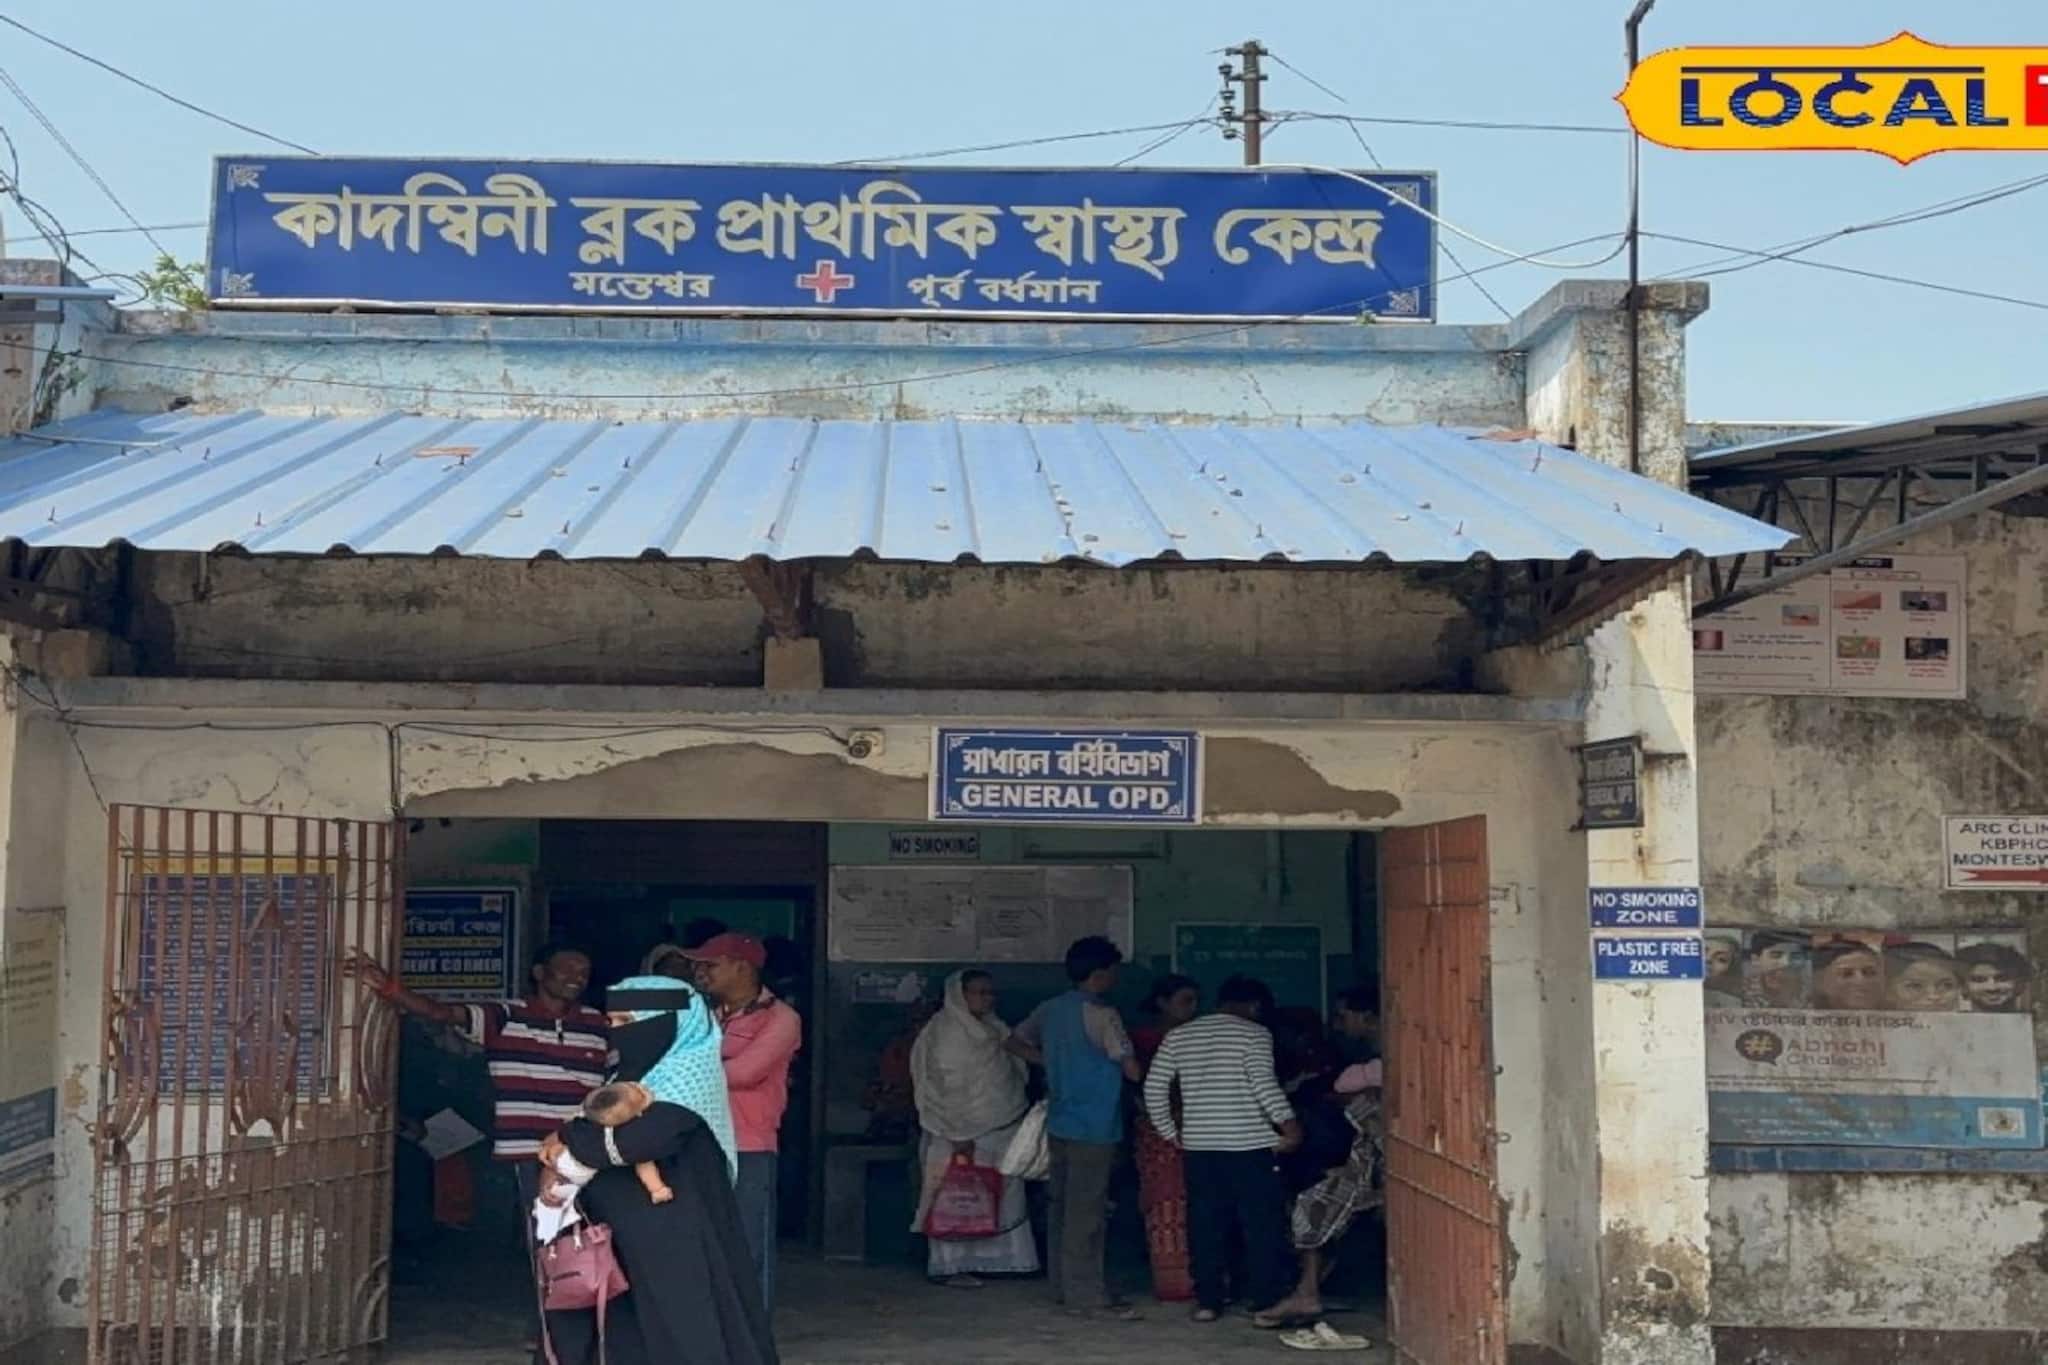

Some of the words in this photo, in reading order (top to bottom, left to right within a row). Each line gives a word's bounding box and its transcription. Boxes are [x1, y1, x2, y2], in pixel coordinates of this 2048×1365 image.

[264, 172, 556, 257] কাদম্বিনী
[570, 197, 701, 265] ব্লক
[715, 180, 1001, 260] প্রাথমিক
[1010, 197, 1186, 281] স্বাস্থ্য
[1213, 207, 1384, 270] কেন্দ্র
[906, 268, 973, 308] পূর্ব
[974, 269, 1102, 304] বর্ধমান
[961, 783, 1099, 809] GENERAL
[1108, 786, 1170, 810] OPD
[1959, 823, 2002, 834] ARC
[891, 837, 911, 854] NO
[914, 837, 977, 855] SMOKING
[1592, 892, 1616, 907] NO
[1620, 892, 1698, 907] SMOKING
[1616, 909, 1679, 924] ZONE
[1598, 941, 1658, 956] PLASTIC
[1661, 941, 1699, 956] FREE
[1629, 960, 1670, 975] ZONE
